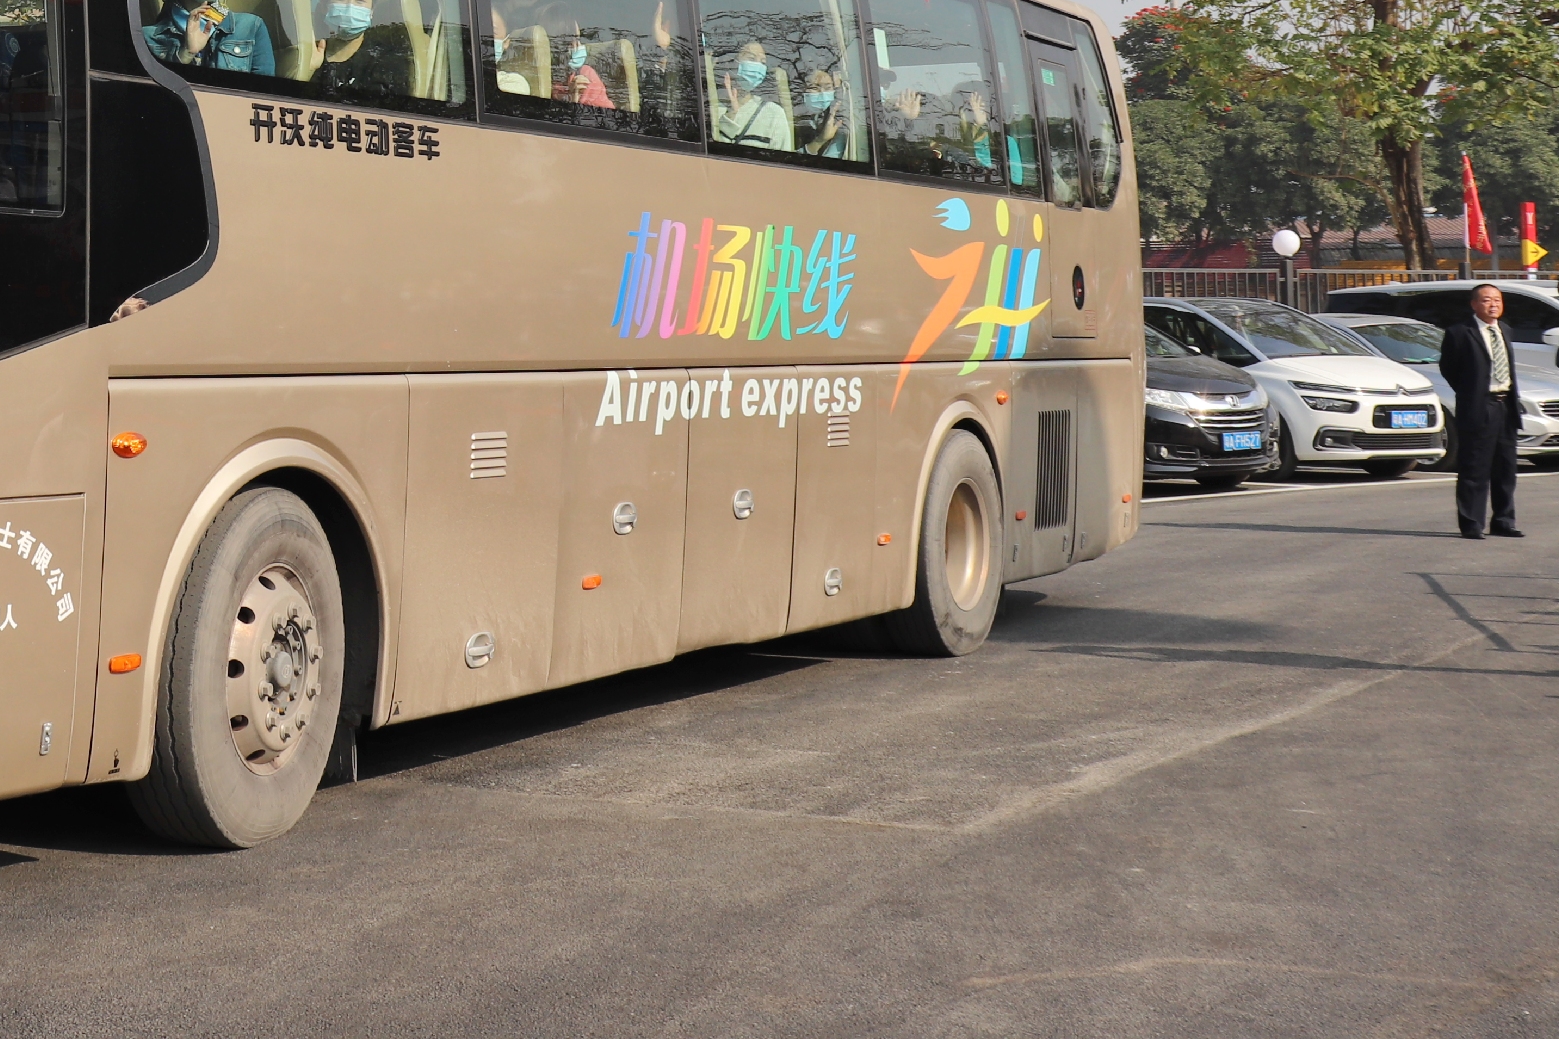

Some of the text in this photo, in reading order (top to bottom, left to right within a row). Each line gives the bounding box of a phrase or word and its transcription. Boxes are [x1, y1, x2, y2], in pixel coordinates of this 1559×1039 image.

[249, 102, 440, 160] 开沃纯电动客车
[610, 211, 857, 340] 机场快线
[595, 369, 863, 435] Airport express
